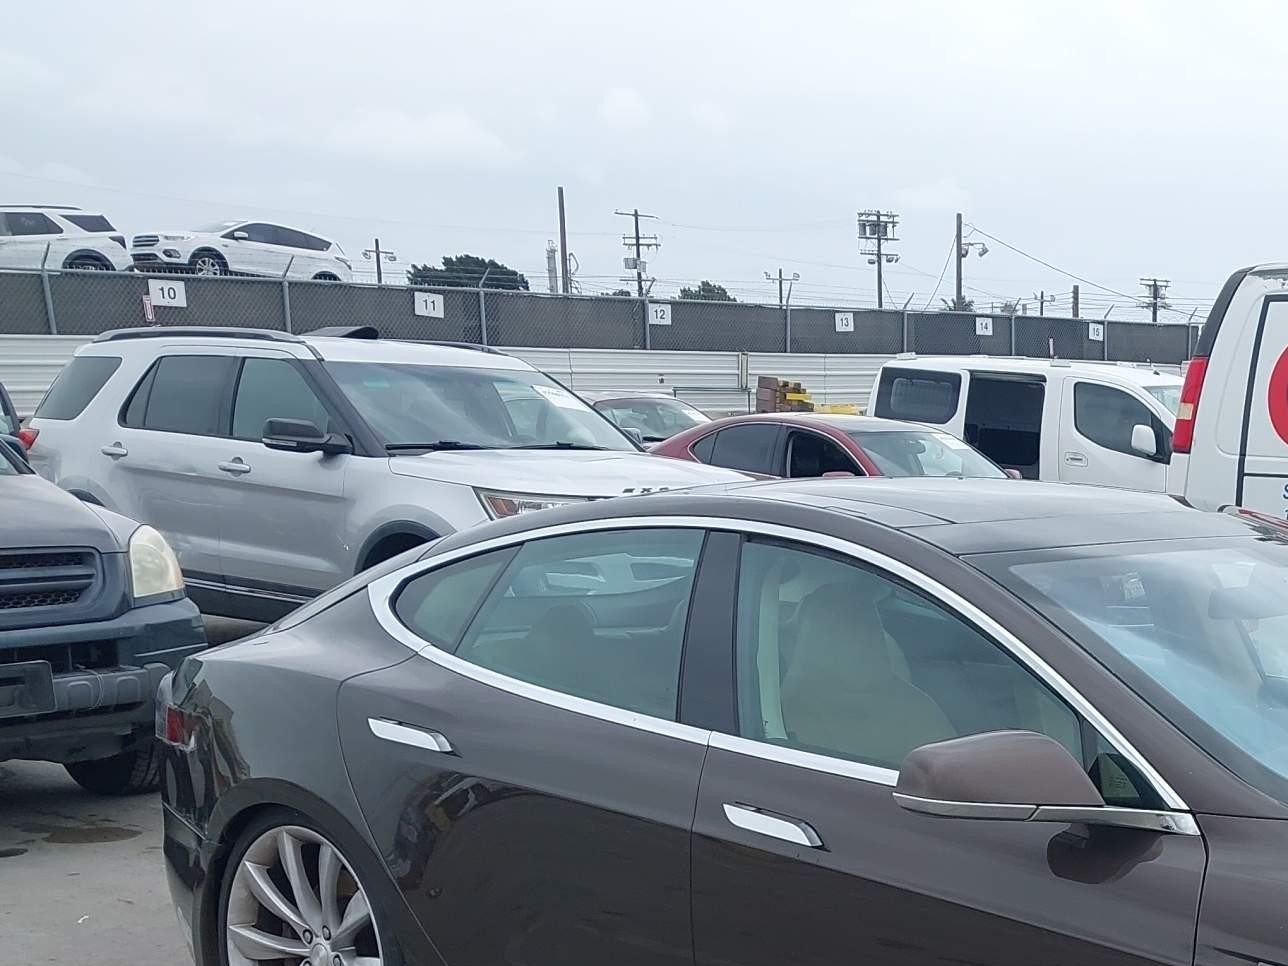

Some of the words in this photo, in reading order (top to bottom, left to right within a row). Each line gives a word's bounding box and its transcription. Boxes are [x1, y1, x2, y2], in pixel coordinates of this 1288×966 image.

[158, 286, 177, 300] 10
[422, 299, 436, 312] 11
[653, 309, 666, 320] 12
[840, 317, 849, 327] 13
[979, 322, 989, 331] 14
